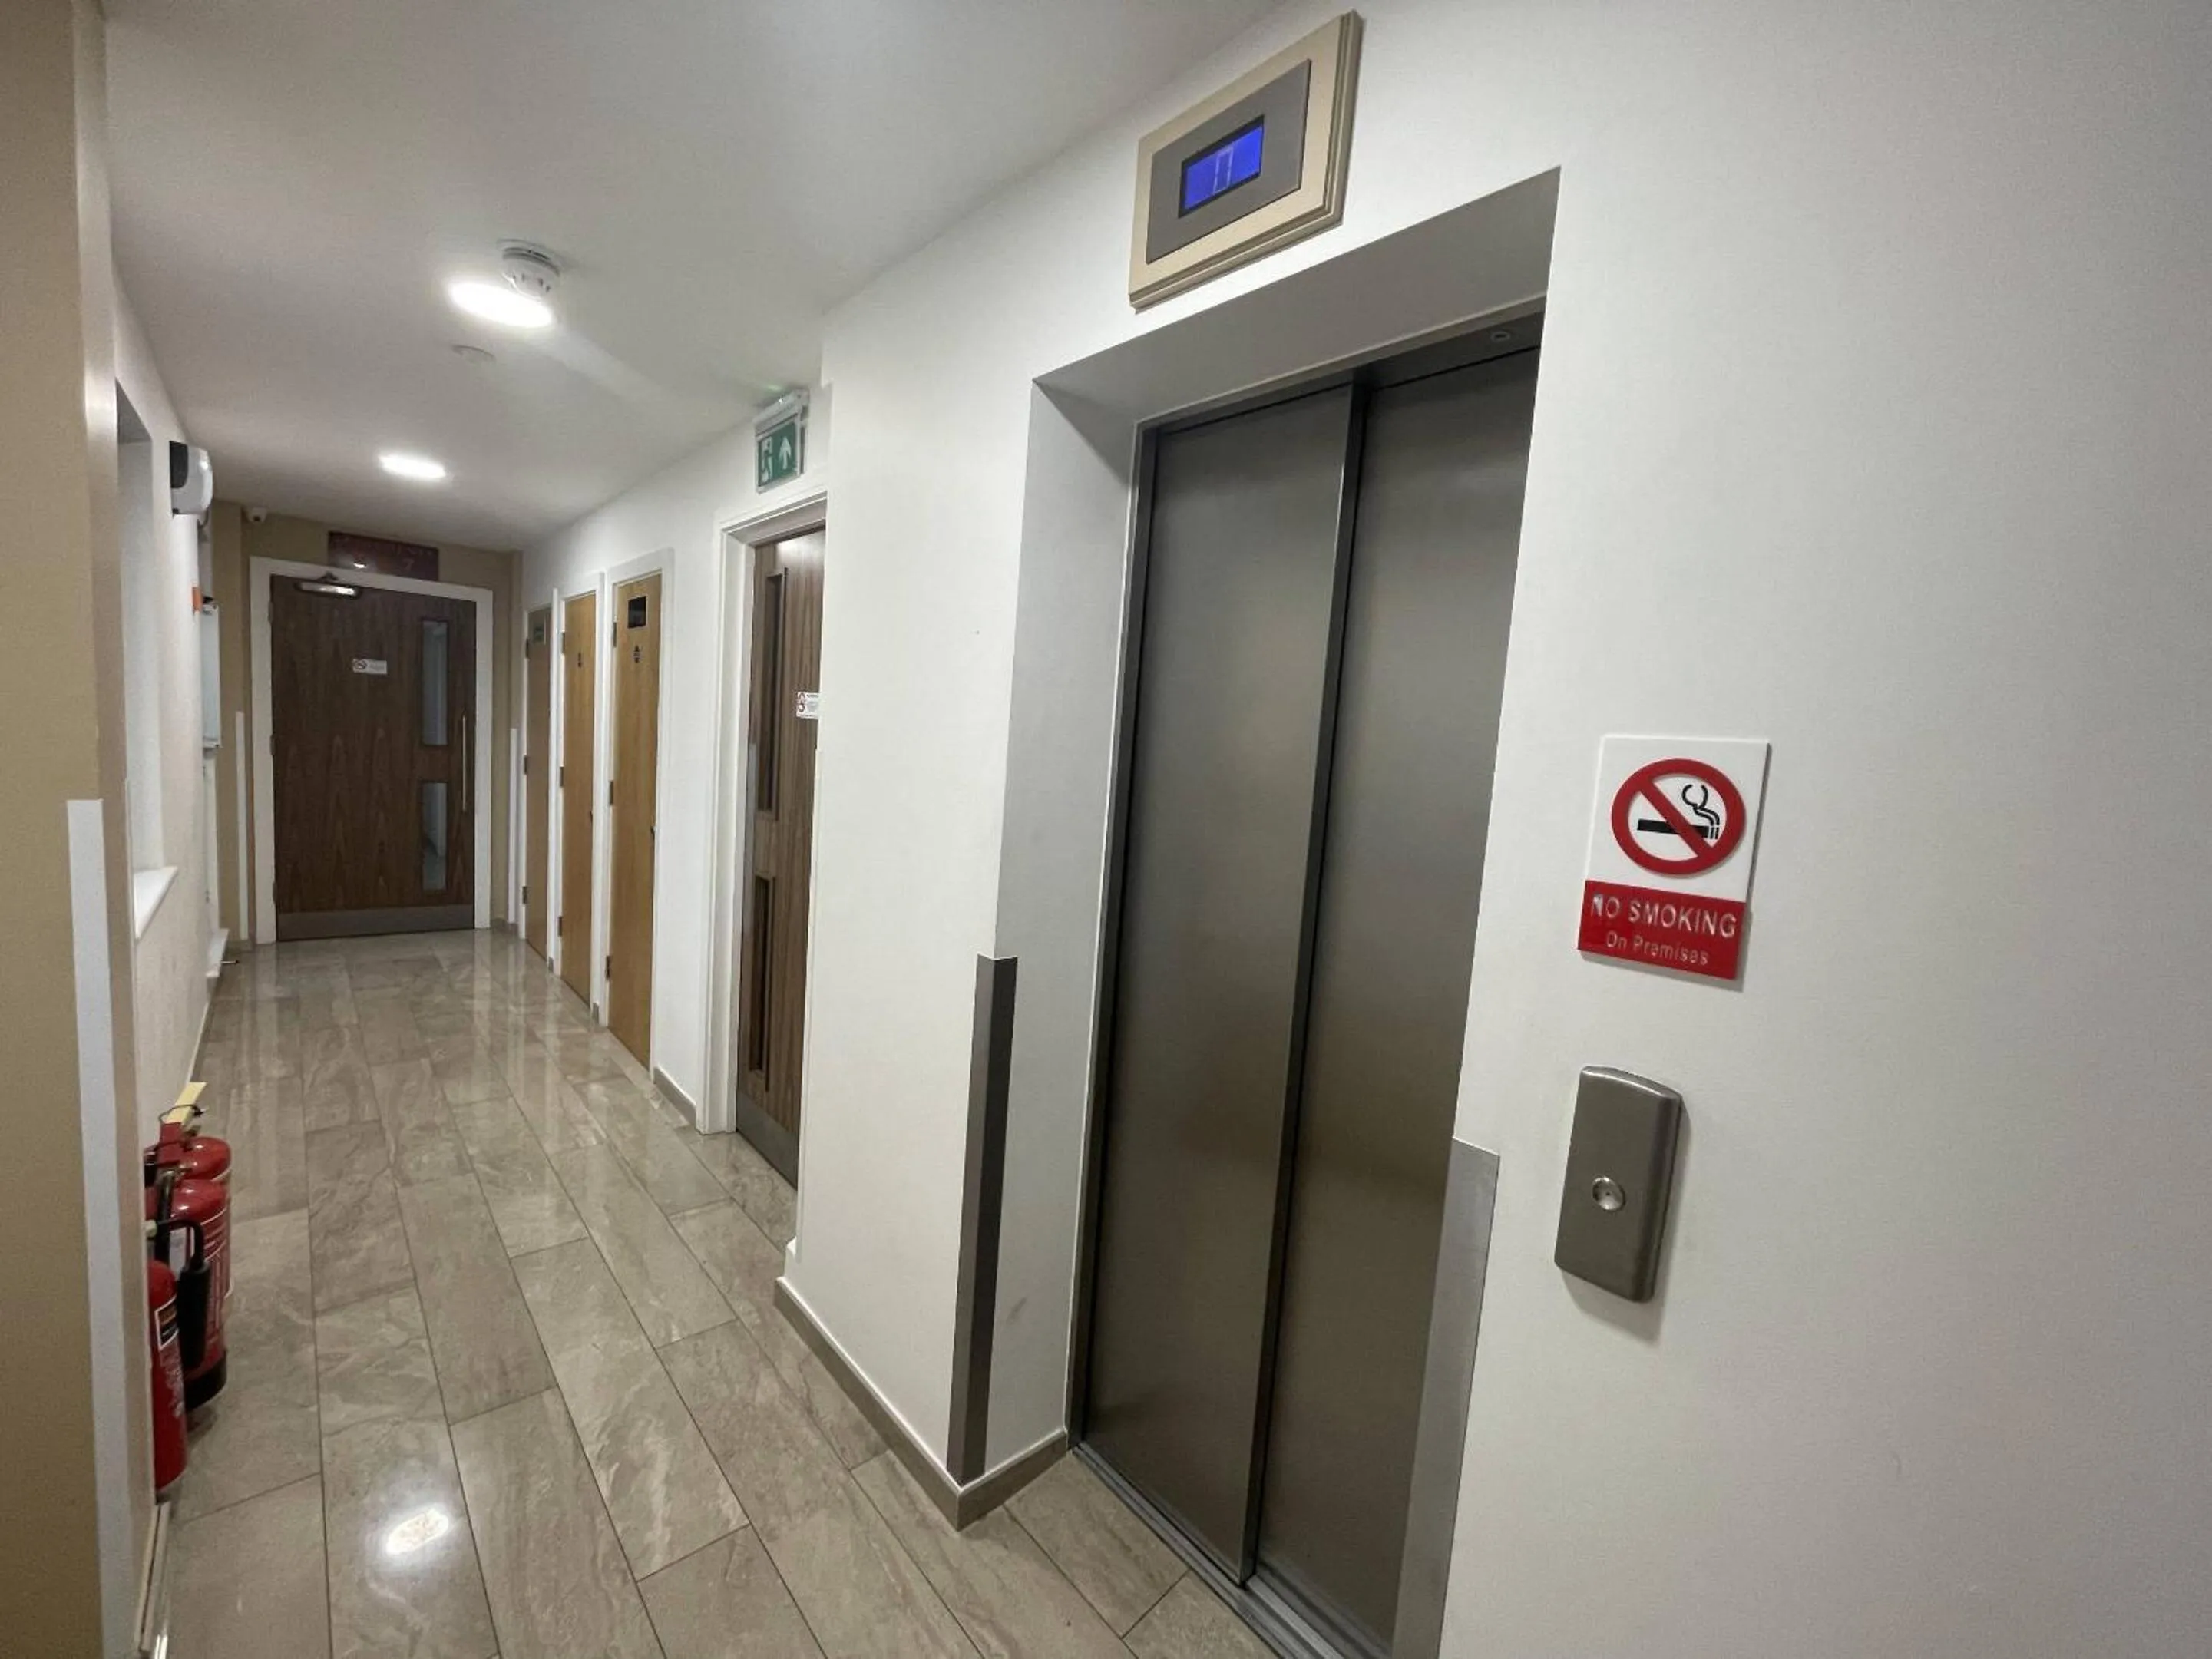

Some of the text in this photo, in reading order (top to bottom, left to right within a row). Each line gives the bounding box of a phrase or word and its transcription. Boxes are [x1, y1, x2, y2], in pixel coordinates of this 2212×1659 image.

[1591, 893, 1737, 939] NO SMOKING
[1606, 930, 1709, 966] On Premises
